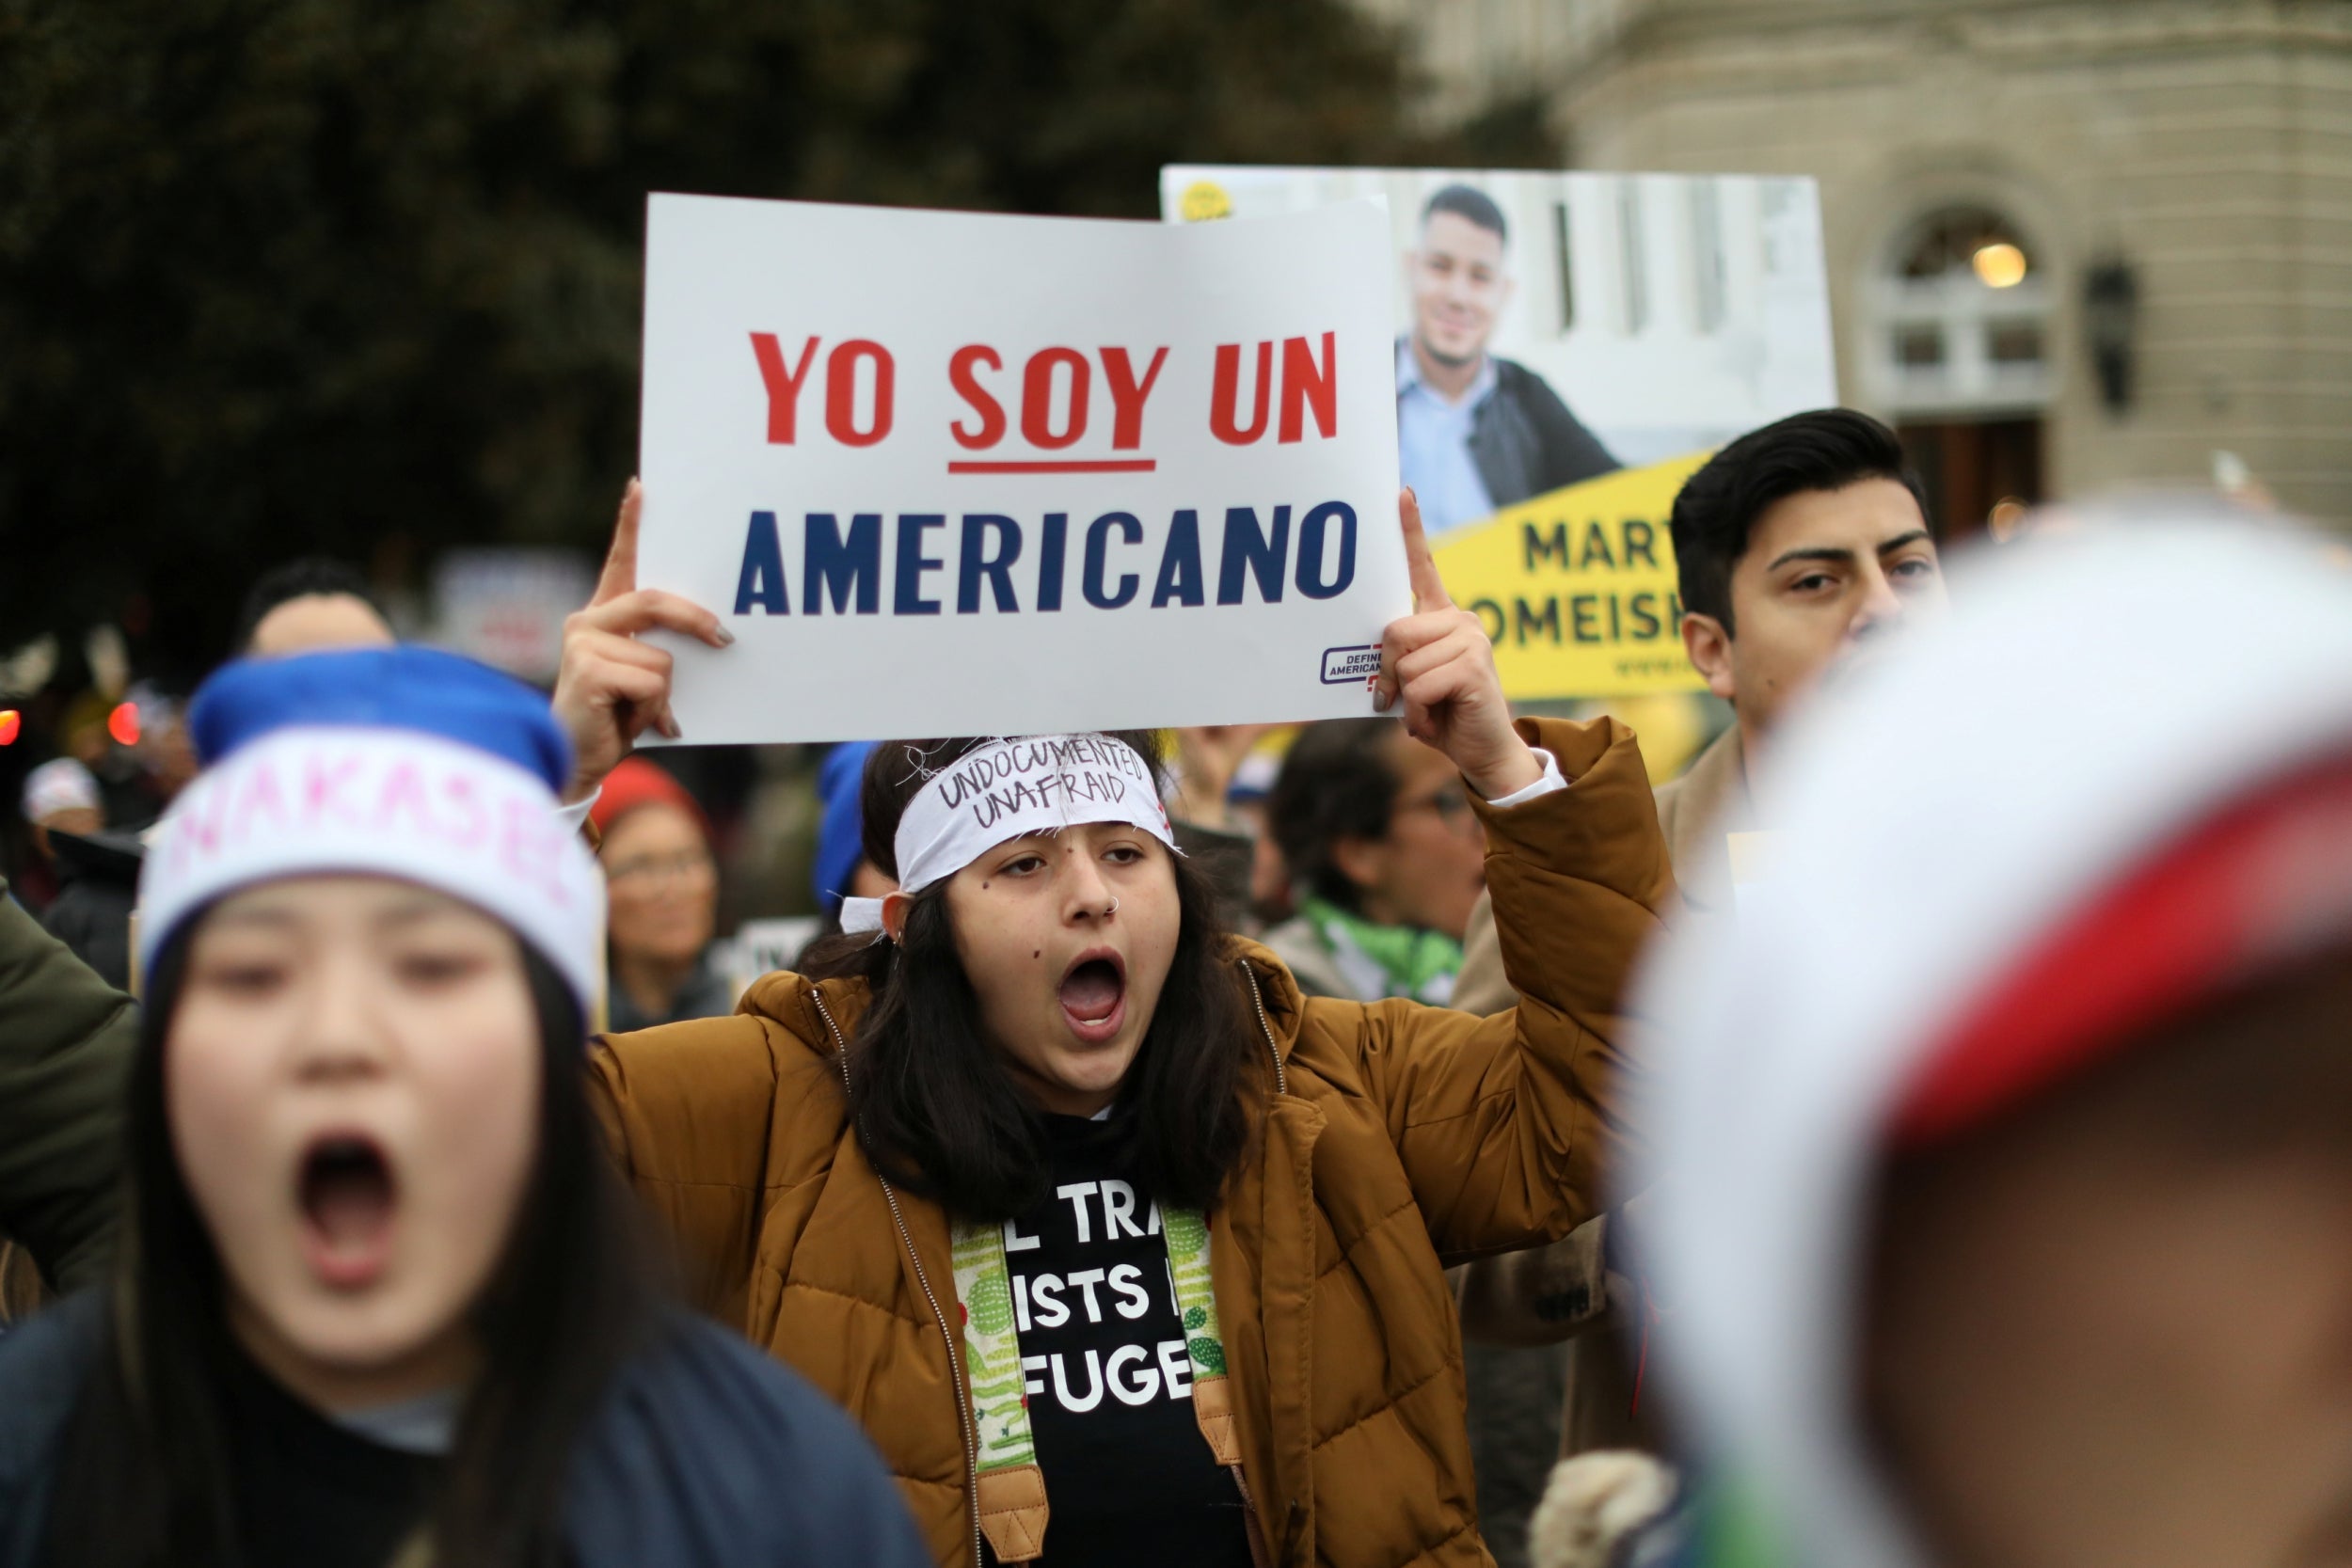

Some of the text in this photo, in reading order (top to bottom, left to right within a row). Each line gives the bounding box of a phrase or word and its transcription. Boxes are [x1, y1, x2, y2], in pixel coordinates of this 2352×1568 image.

[749, 330, 1338, 451] YO SOY UN
[733, 500, 1358, 616] AMERICANO
[1522, 517, 1671, 572] MAR
[939, 738, 1143, 809] UNDOCUMENTED
[973, 771, 1126, 830] UNAFRAID
